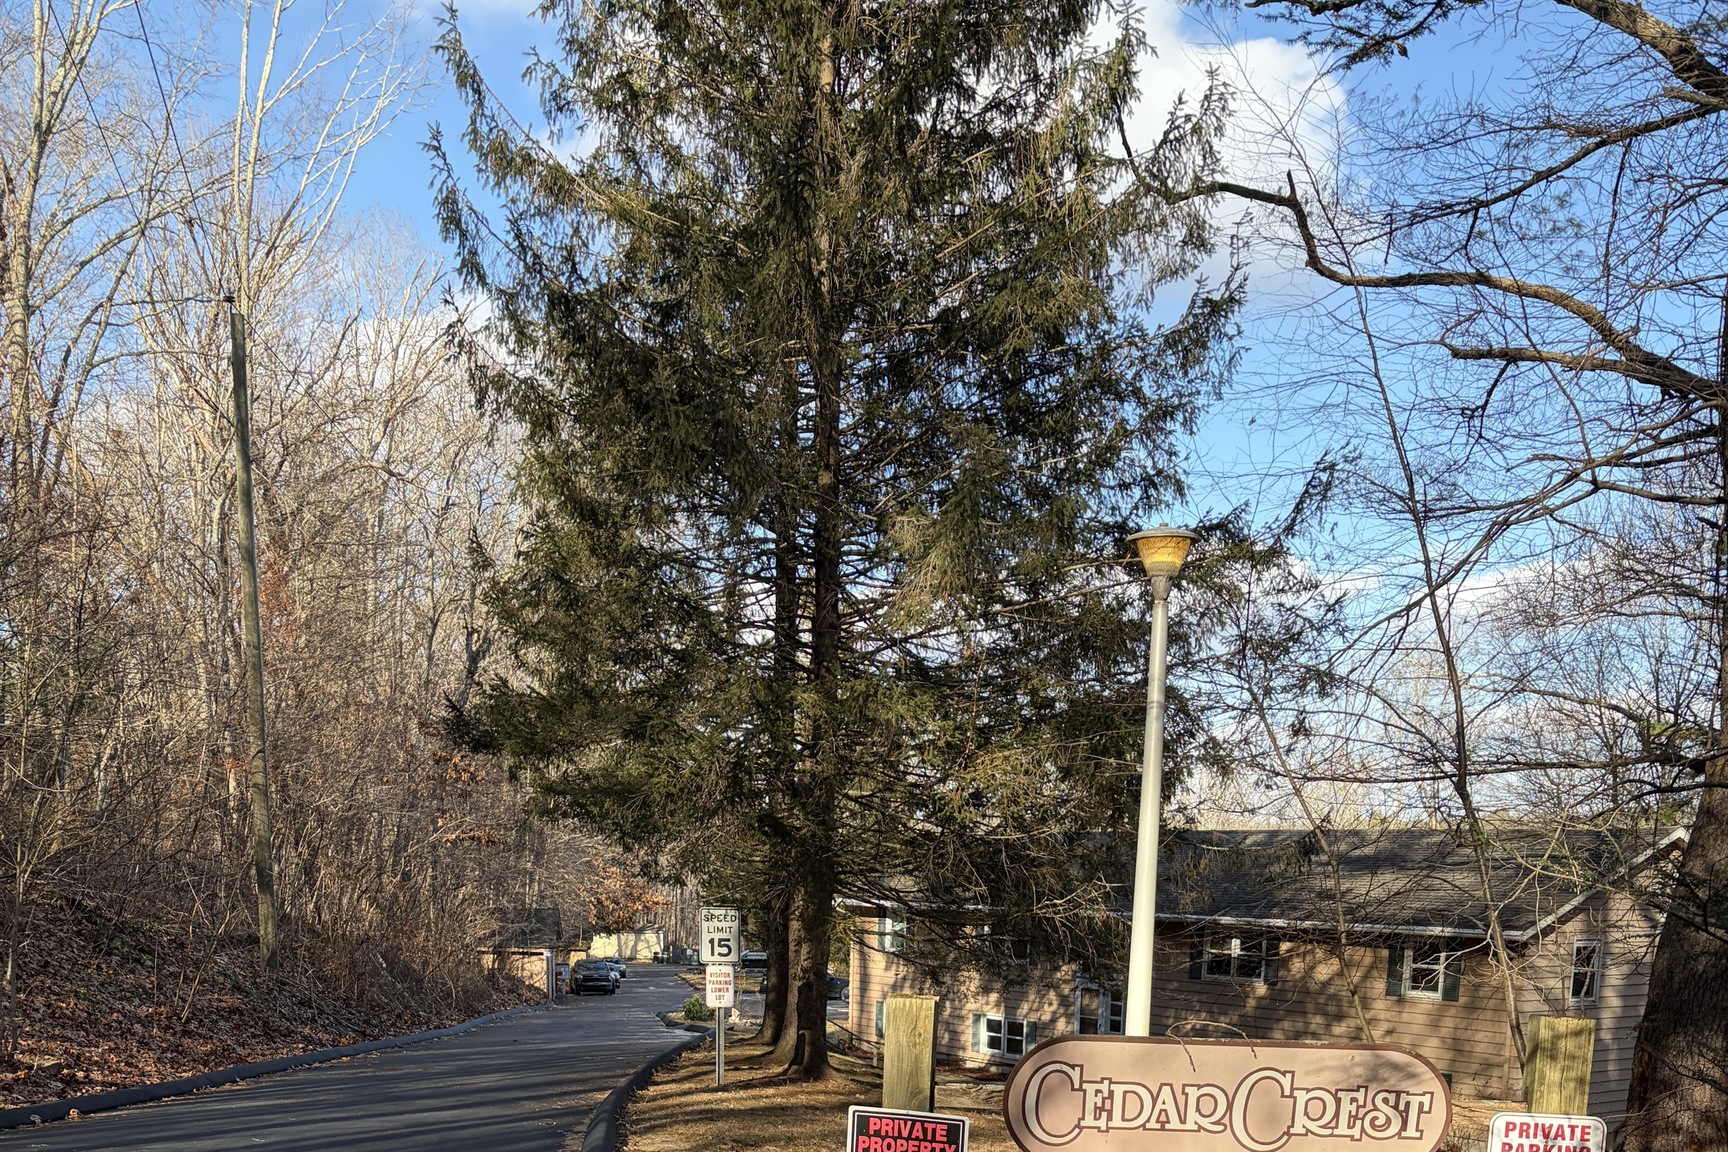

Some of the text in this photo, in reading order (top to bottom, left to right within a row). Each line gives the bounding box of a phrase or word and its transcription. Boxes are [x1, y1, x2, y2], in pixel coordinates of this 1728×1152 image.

[703, 914, 737, 922] SPEED
[708, 938, 732, 957] 15
[868, 1117, 948, 1142] PRIVATE
[1504, 1121, 1591, 1142] PRIVATE
